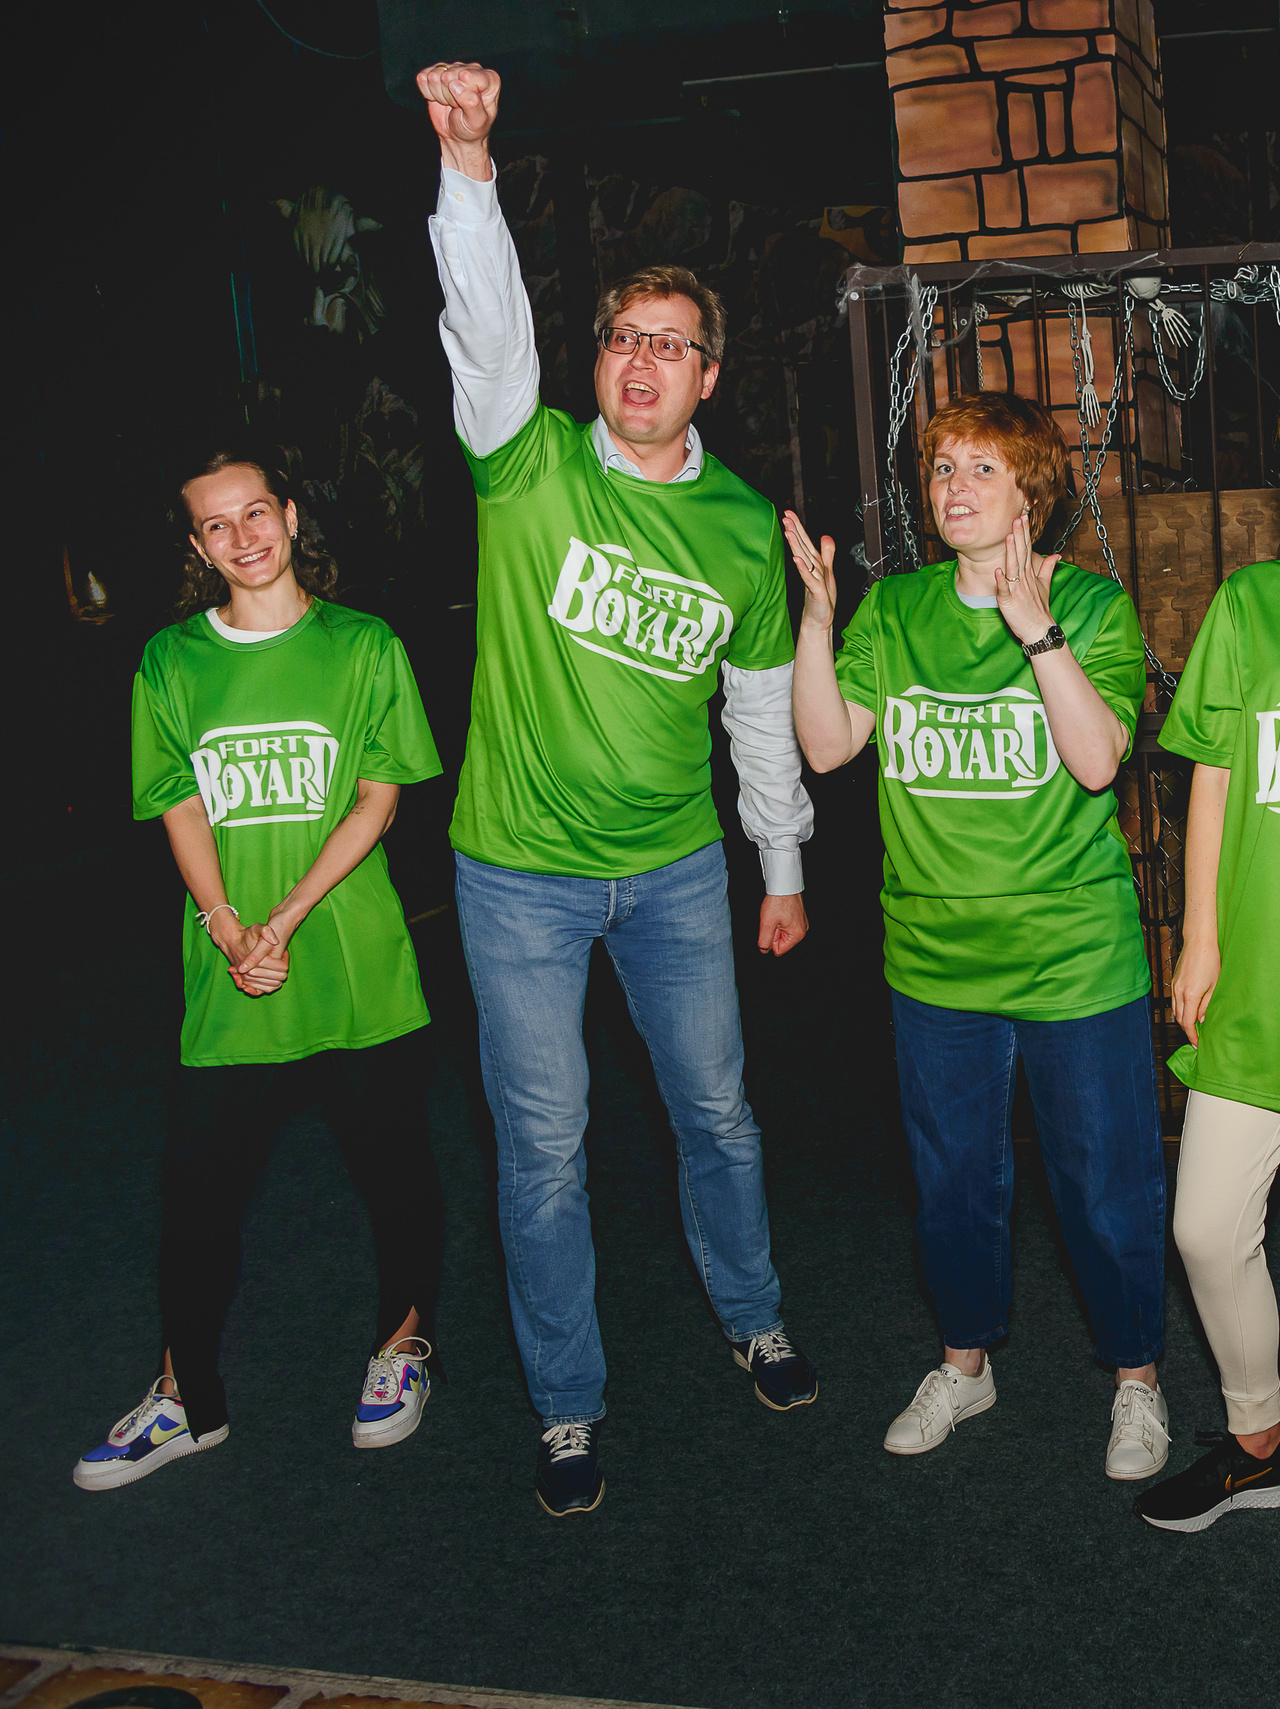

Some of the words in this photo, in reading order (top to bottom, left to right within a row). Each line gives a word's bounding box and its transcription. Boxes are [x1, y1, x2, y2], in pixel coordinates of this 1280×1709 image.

[547, 536, 734, 675] BOYARD
[612, 563, 697, 612] FORT
[218, 735, 302, 760] FORT
[883, 696, 1061, 788] BOYARD
[919, 701, 1006, 724] FORT
[189, 735, 340, 827] BOYARD
